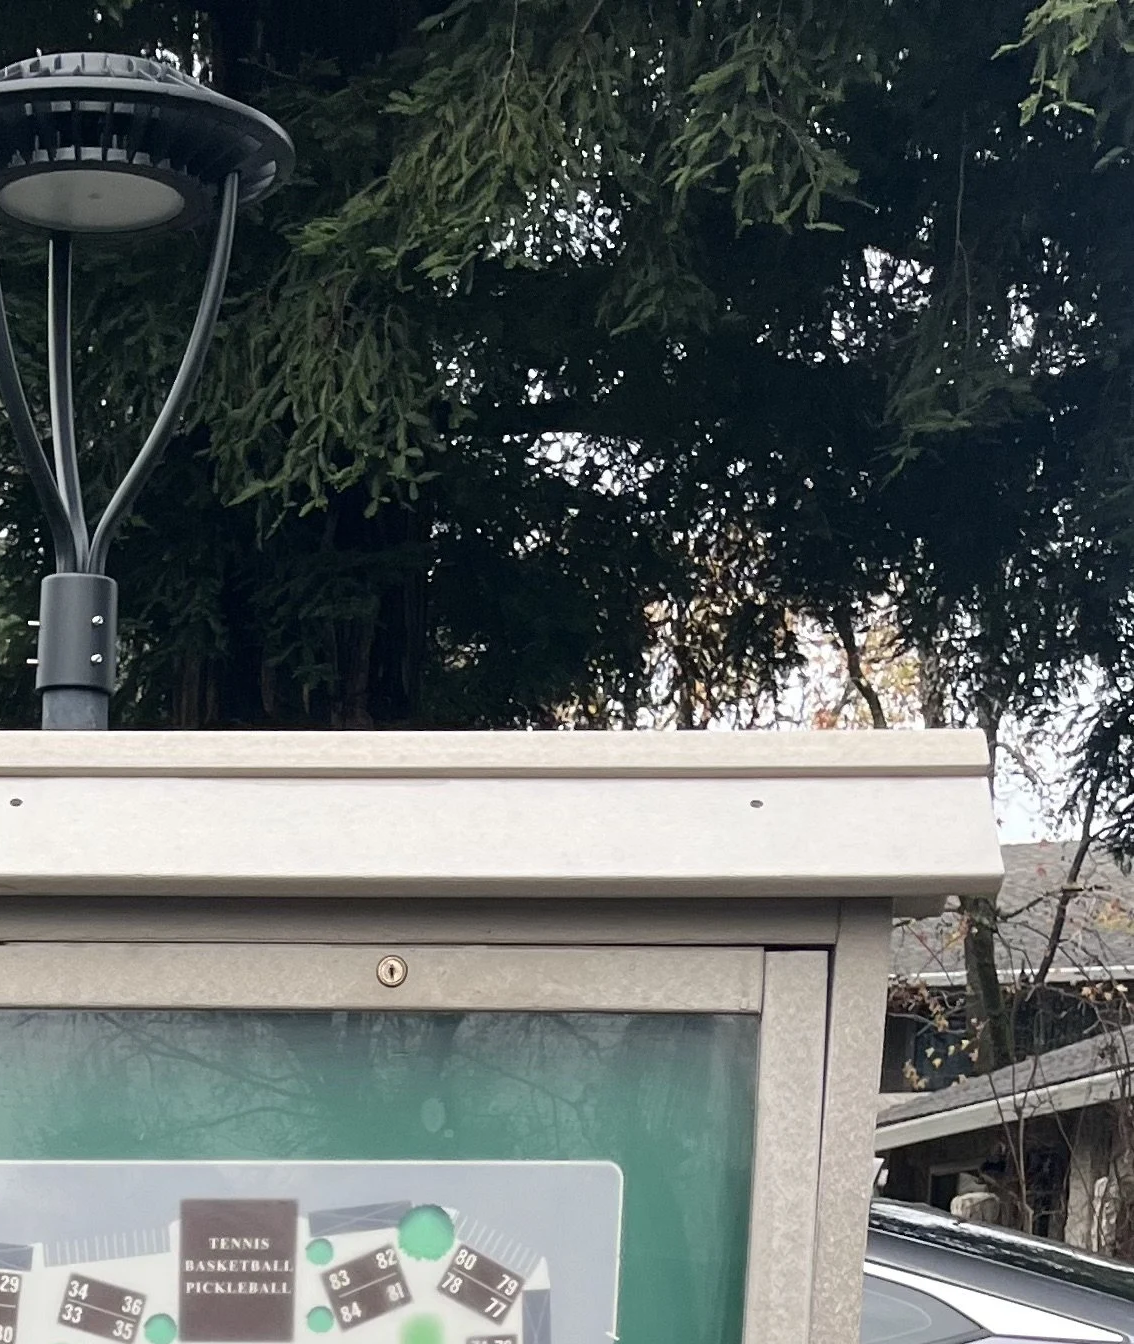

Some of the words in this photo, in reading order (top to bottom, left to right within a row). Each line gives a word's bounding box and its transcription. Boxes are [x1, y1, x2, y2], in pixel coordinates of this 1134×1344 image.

[209, 1238, 270, 1249] TENNIS
[186, 1260, 293, 1271] BASKETBALL
[376, 1249, 398, 1269] 82
[455, 1249, 477, 1270] 80
[0, 1276, 19, 1292] 29
[186, 1282, 291, 1293] PICKLEBALL
[329, 1270, 350, 1290] 83
[442, 1273, 463, 1294] 78
[496, 1274, 519, 1296] 79
[69, 1281, 88, 1300] 34
[386, 1282, 404, 1301] 81
[62, 1304, 82, 1323] 33
[121, 1296, 142, 1316] 36
[341, 1302, 361, 1323] 84
[484, 1297, 507, 1318] 77
[113, 1320, 133, 1340] 35
